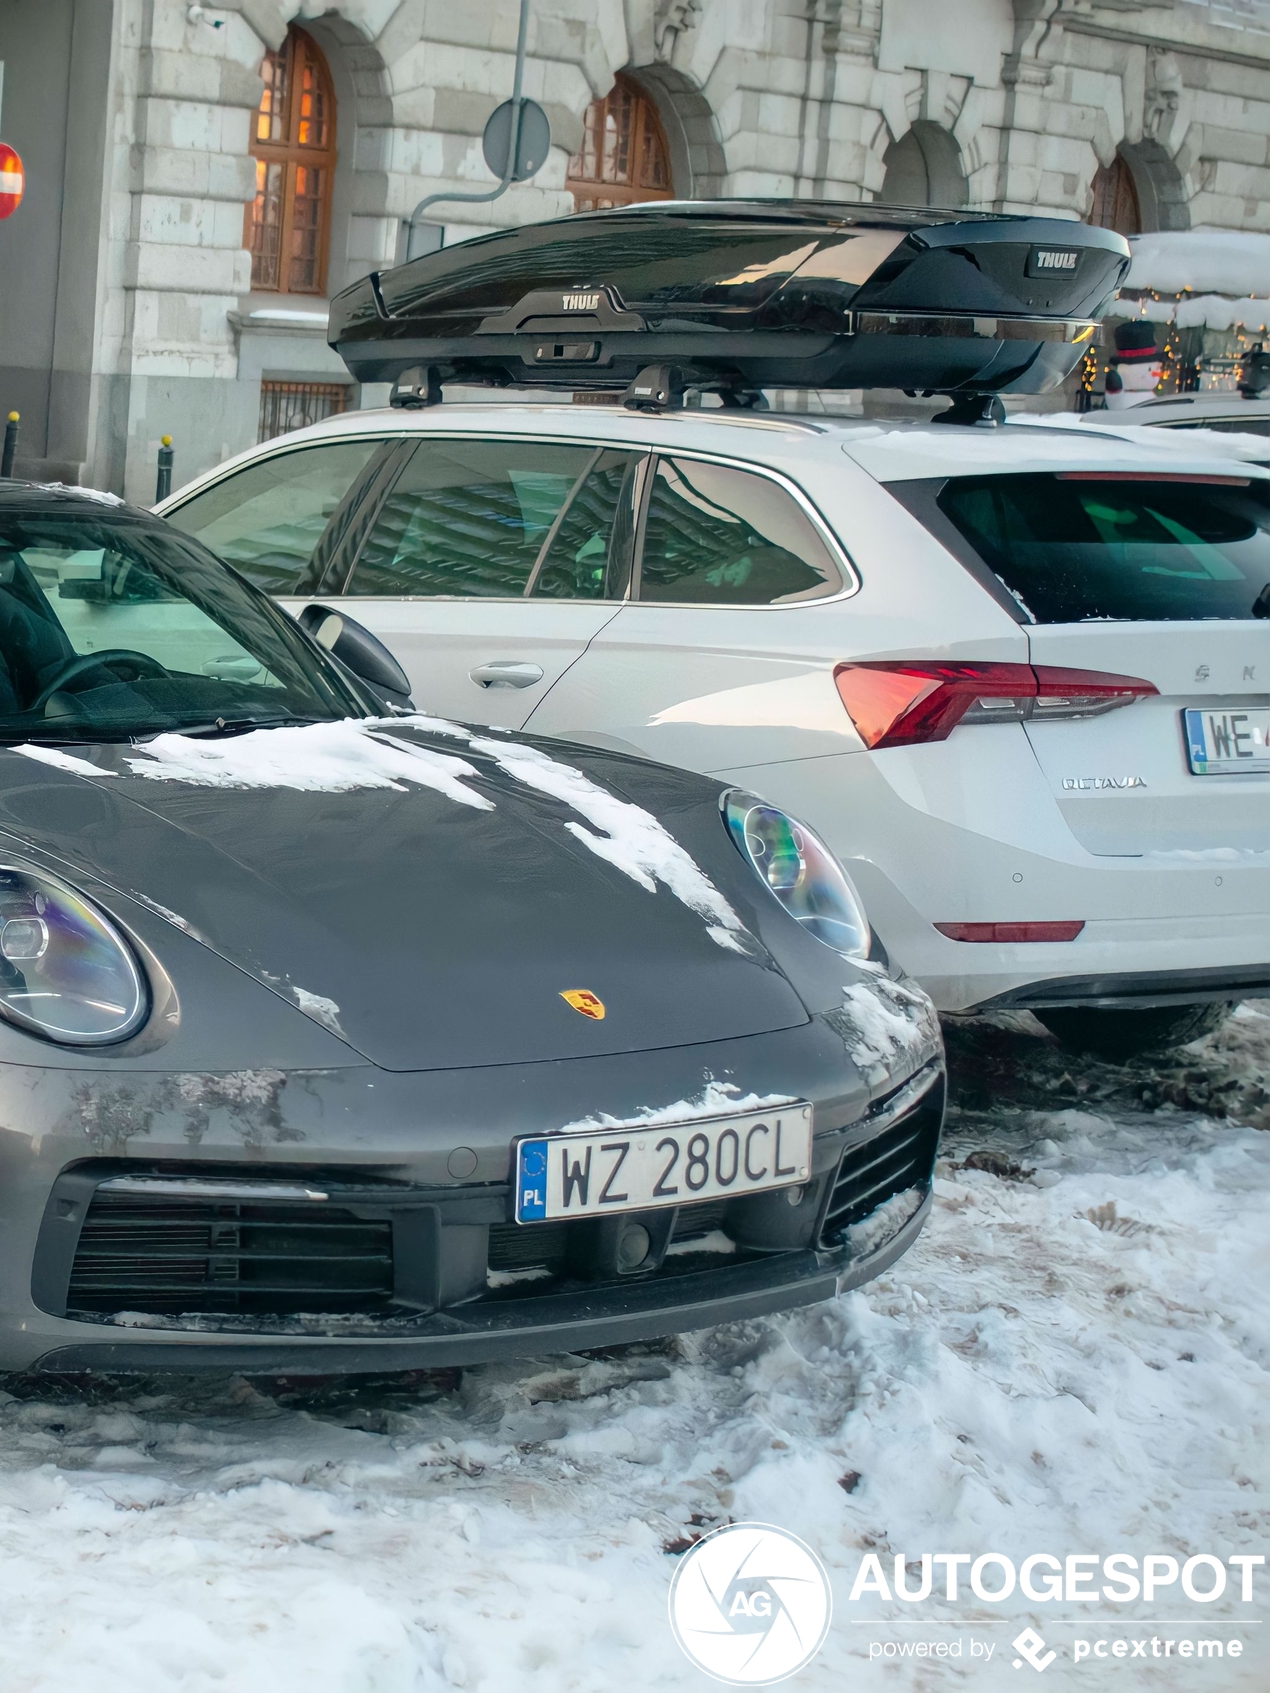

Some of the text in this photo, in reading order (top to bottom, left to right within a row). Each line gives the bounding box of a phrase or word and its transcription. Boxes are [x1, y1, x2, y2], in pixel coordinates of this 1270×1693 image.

[1037, 251, 1078, 269] THULE
[562, 294, 600, 310] THULE
[1209, 714, 1254, 759] WE
[1061, 776, 1148, 791] OCTAVIA
[561, 1119, 797, 1208] WZ 280CL
[523, 1189, 544, 1207] PL
